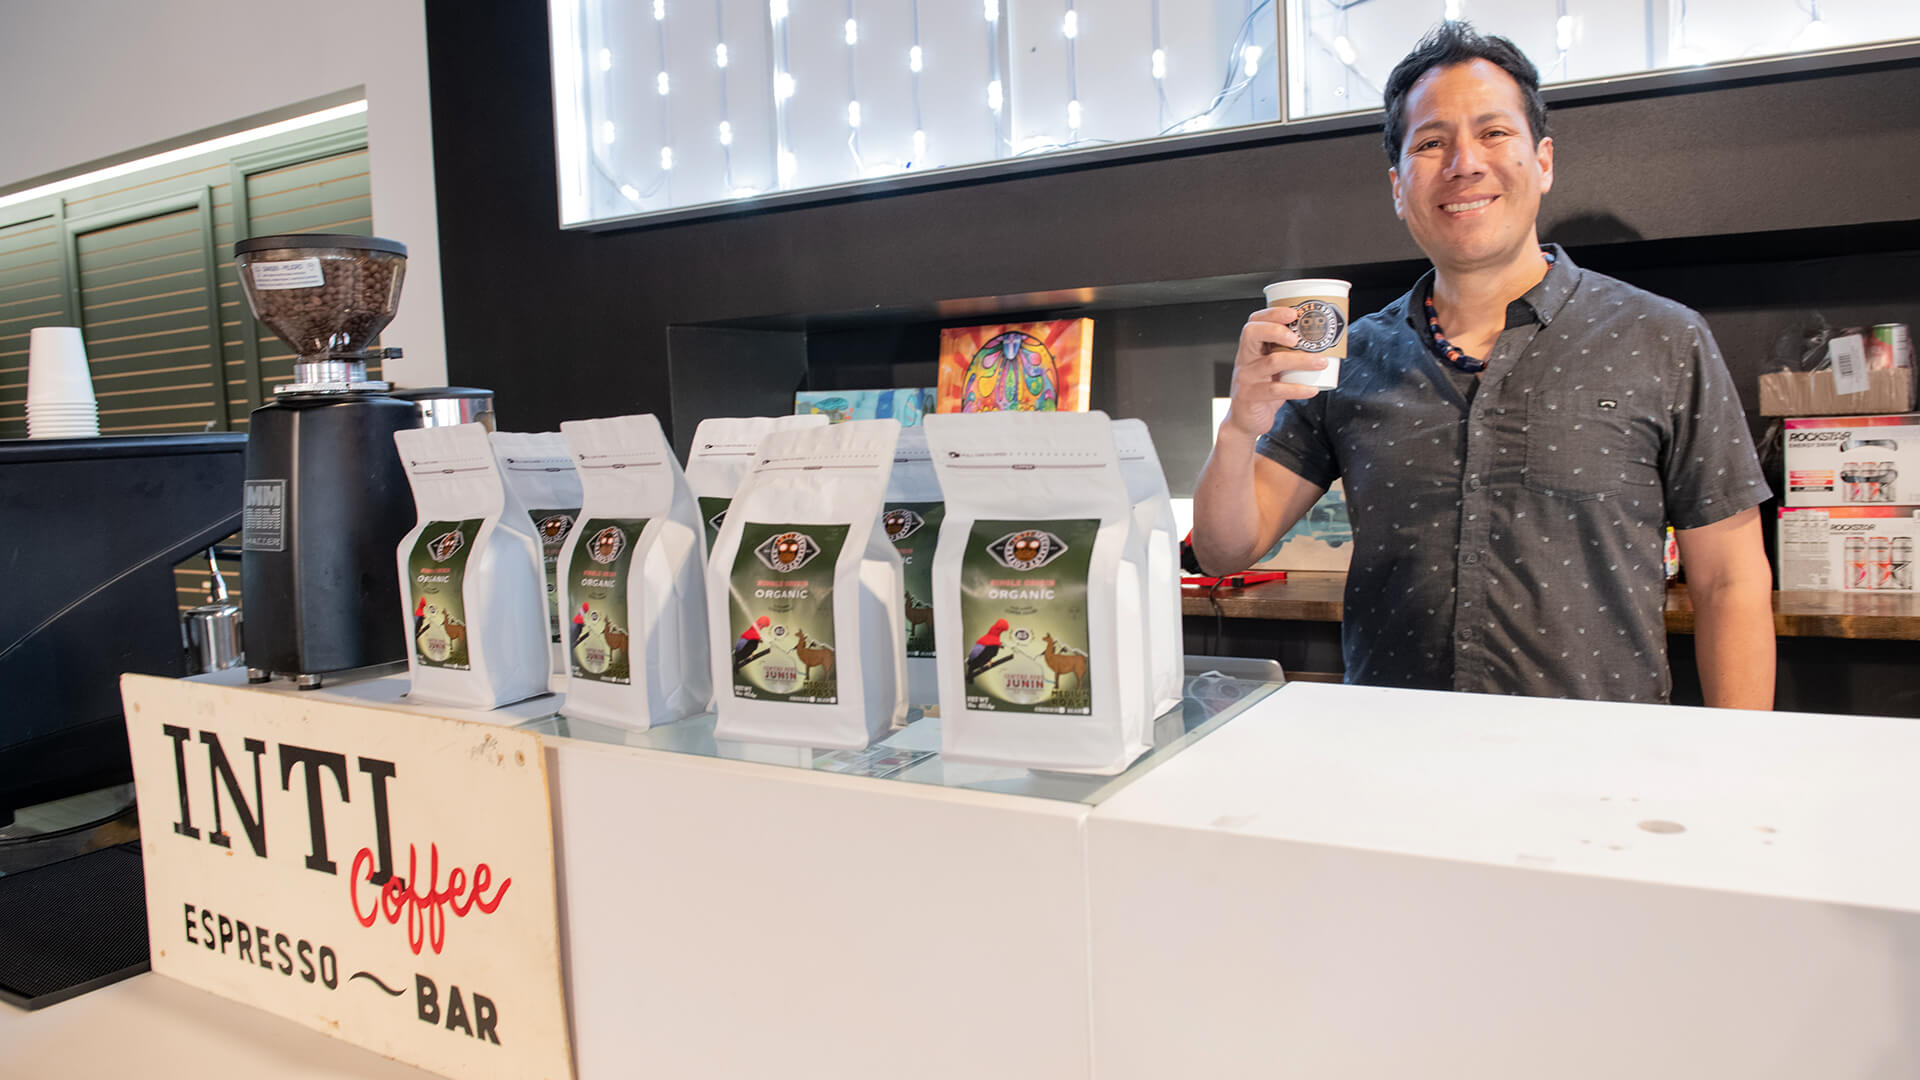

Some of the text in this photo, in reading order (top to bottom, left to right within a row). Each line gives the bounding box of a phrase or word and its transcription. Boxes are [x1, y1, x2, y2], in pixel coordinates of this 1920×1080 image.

[1789, 431, 1852, 442] ROCKSTAR
[755, 589, 809, 599] ORGANIC
[988, 589, 1056, 600] ORGANIC
[1005, 680, 1045, 689] JUNIN
[162, 723, 405, 891] INTI
[350, 842, 512, 955] Coffee
[184, 903, 502, 1045] ESPRESSO BAR
